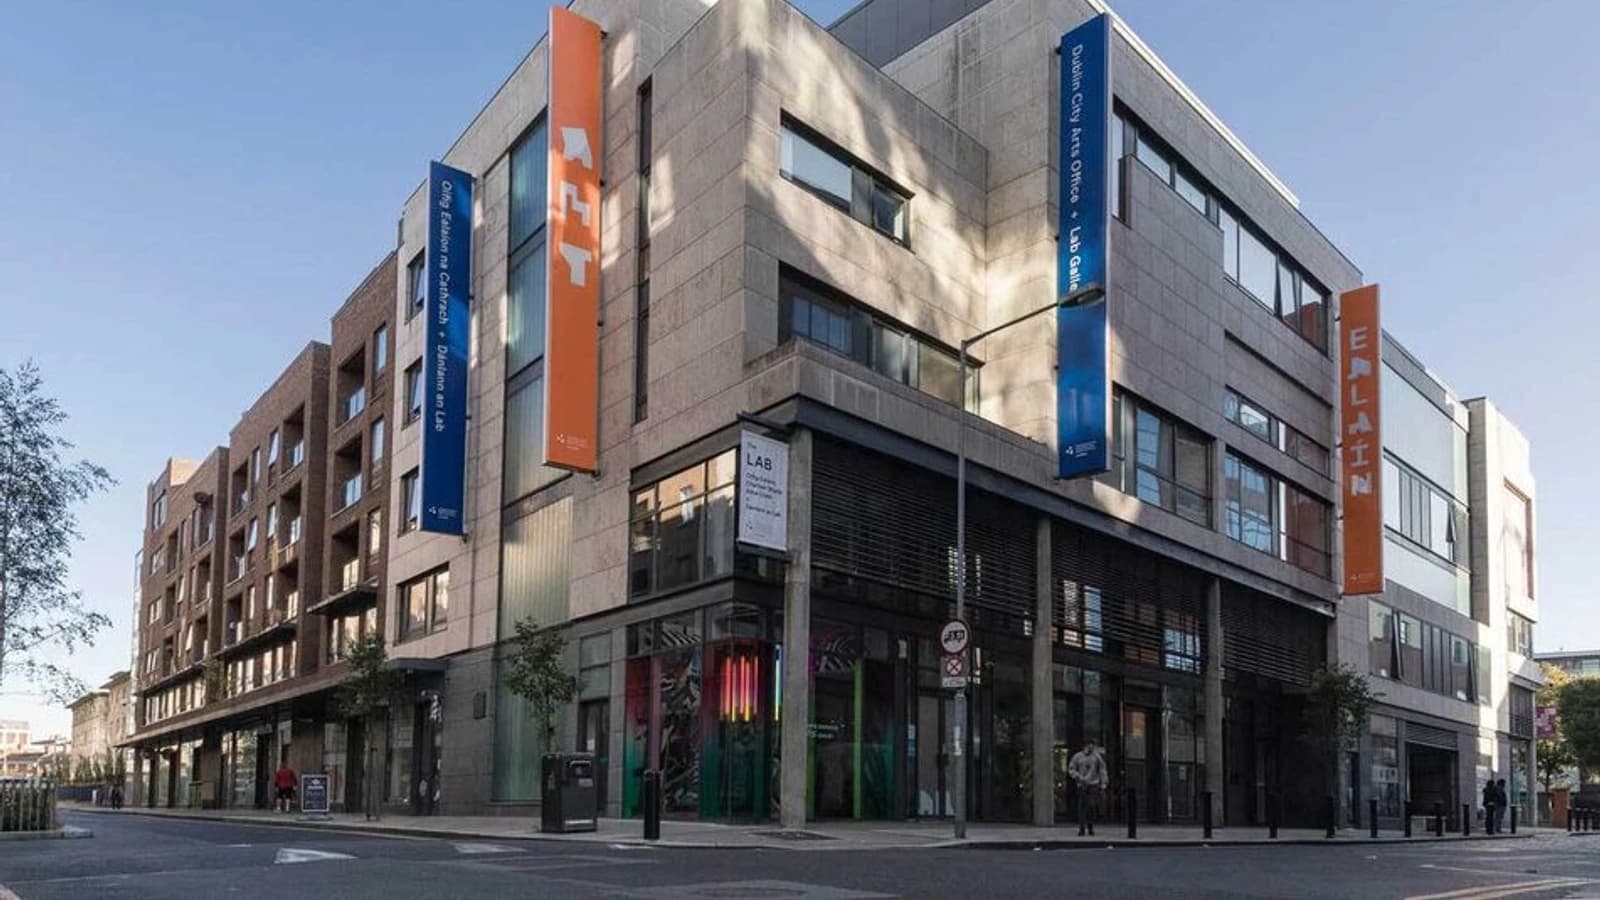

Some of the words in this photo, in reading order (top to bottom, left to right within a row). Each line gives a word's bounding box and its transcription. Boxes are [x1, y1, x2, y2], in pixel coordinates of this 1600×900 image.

[1071, 44, 1083, 92] Dublin
[1069, 93, 1083, 122] City
[1071, 128, 1082, 158] Arts
[440, 181, 452, 209] Oifig
[1070, 160, 1081, 203] Office
[1070, 226, 1081, 253] Lab
[440, 255, 449, 270] na
[1070, 256, 1082, 291] Galle
[439, 272, 450, 325] Cathrach
[436, 393, 444, 408] an
[435, 411, 446, 432] Lab
[746, 453, 772, 471] LAB
